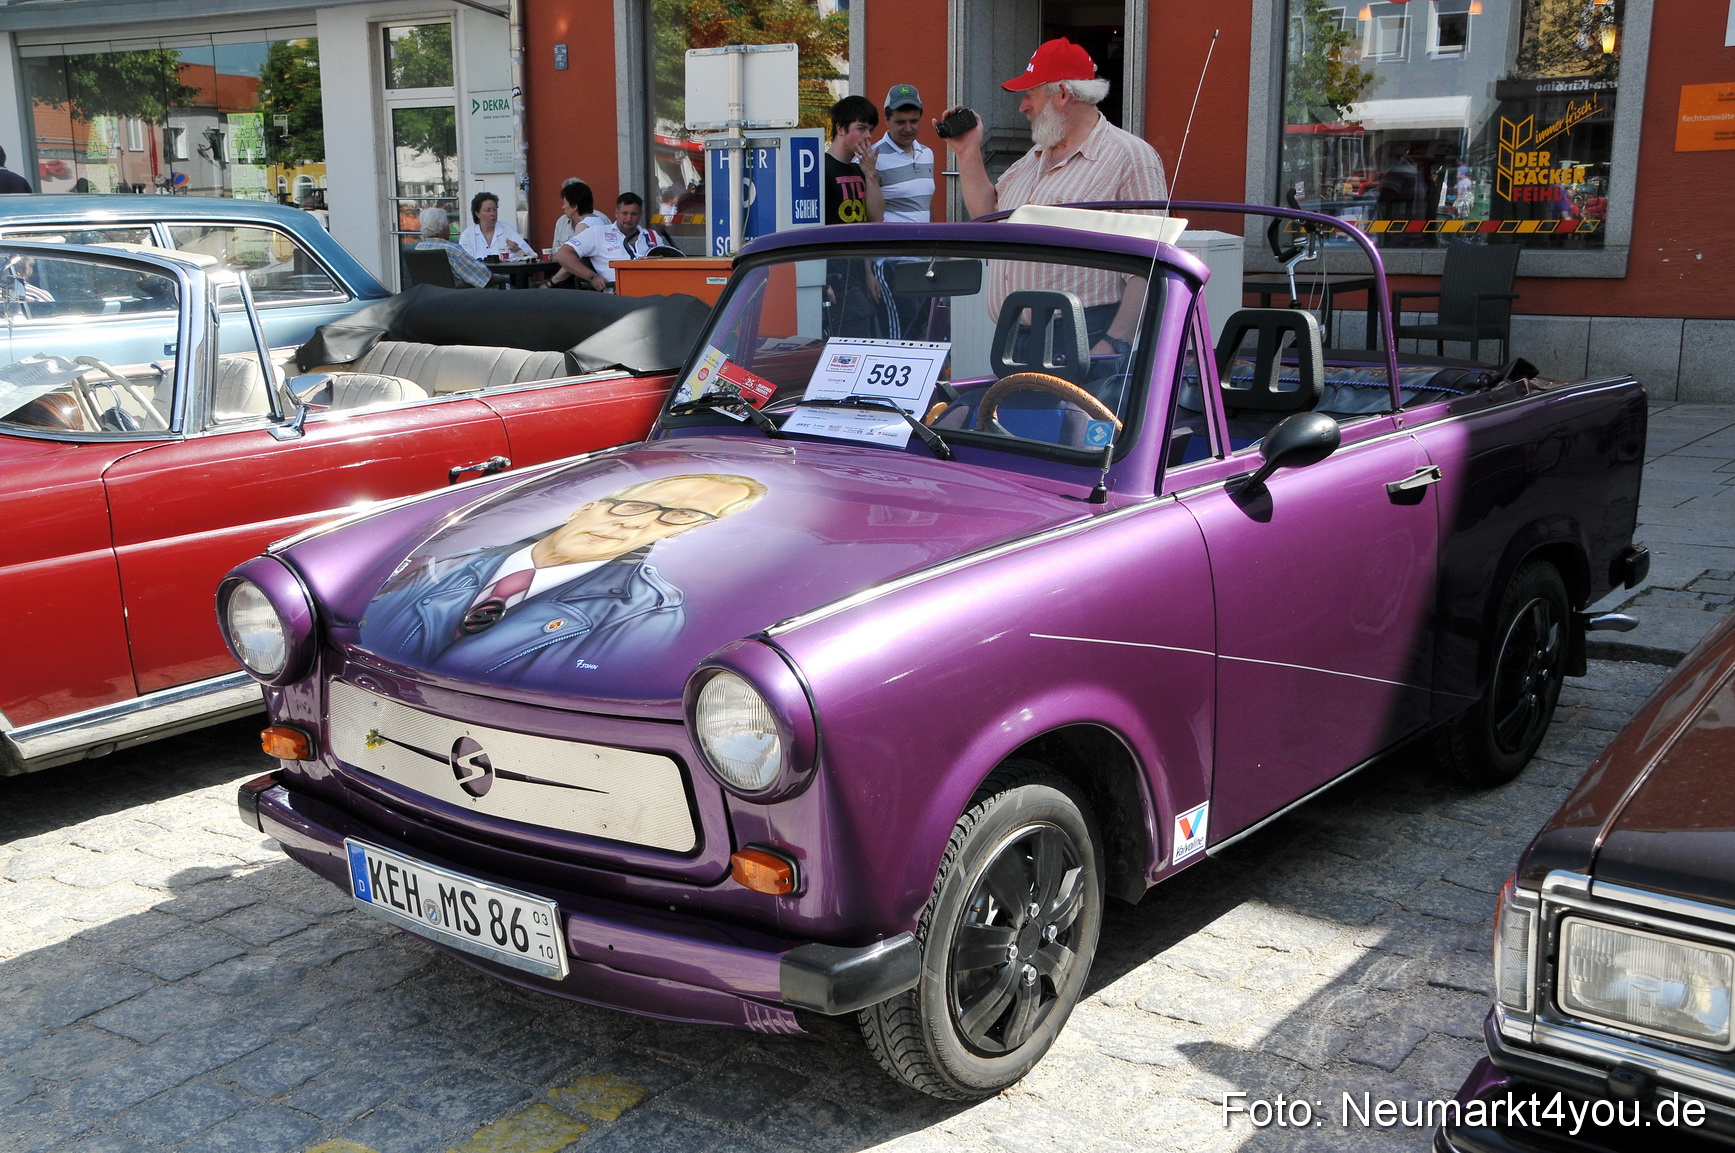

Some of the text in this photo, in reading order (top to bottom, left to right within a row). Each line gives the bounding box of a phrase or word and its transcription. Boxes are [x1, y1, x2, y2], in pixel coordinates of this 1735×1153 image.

[483, 98, 510, 112] DEKRA
[1535, 118, 1565, 144] immer
[719, 149, 768, 169] HER
[799, 149, 815, 188] P
[1514, 151, 1551, 168] DER
[1513, 167, 1588, 186] BÄCKER
[795, 199, 818, 219] SCHEINE
[866, 363, 912, 388] 593
[1176, 837, 1204, 858] Valvoline
[358, 879, 366, 892] D
[367, 856, 529, 953] KEH MS 86
[533, 911, 549, 926] 03
[538, 944, 554, 960] 10
